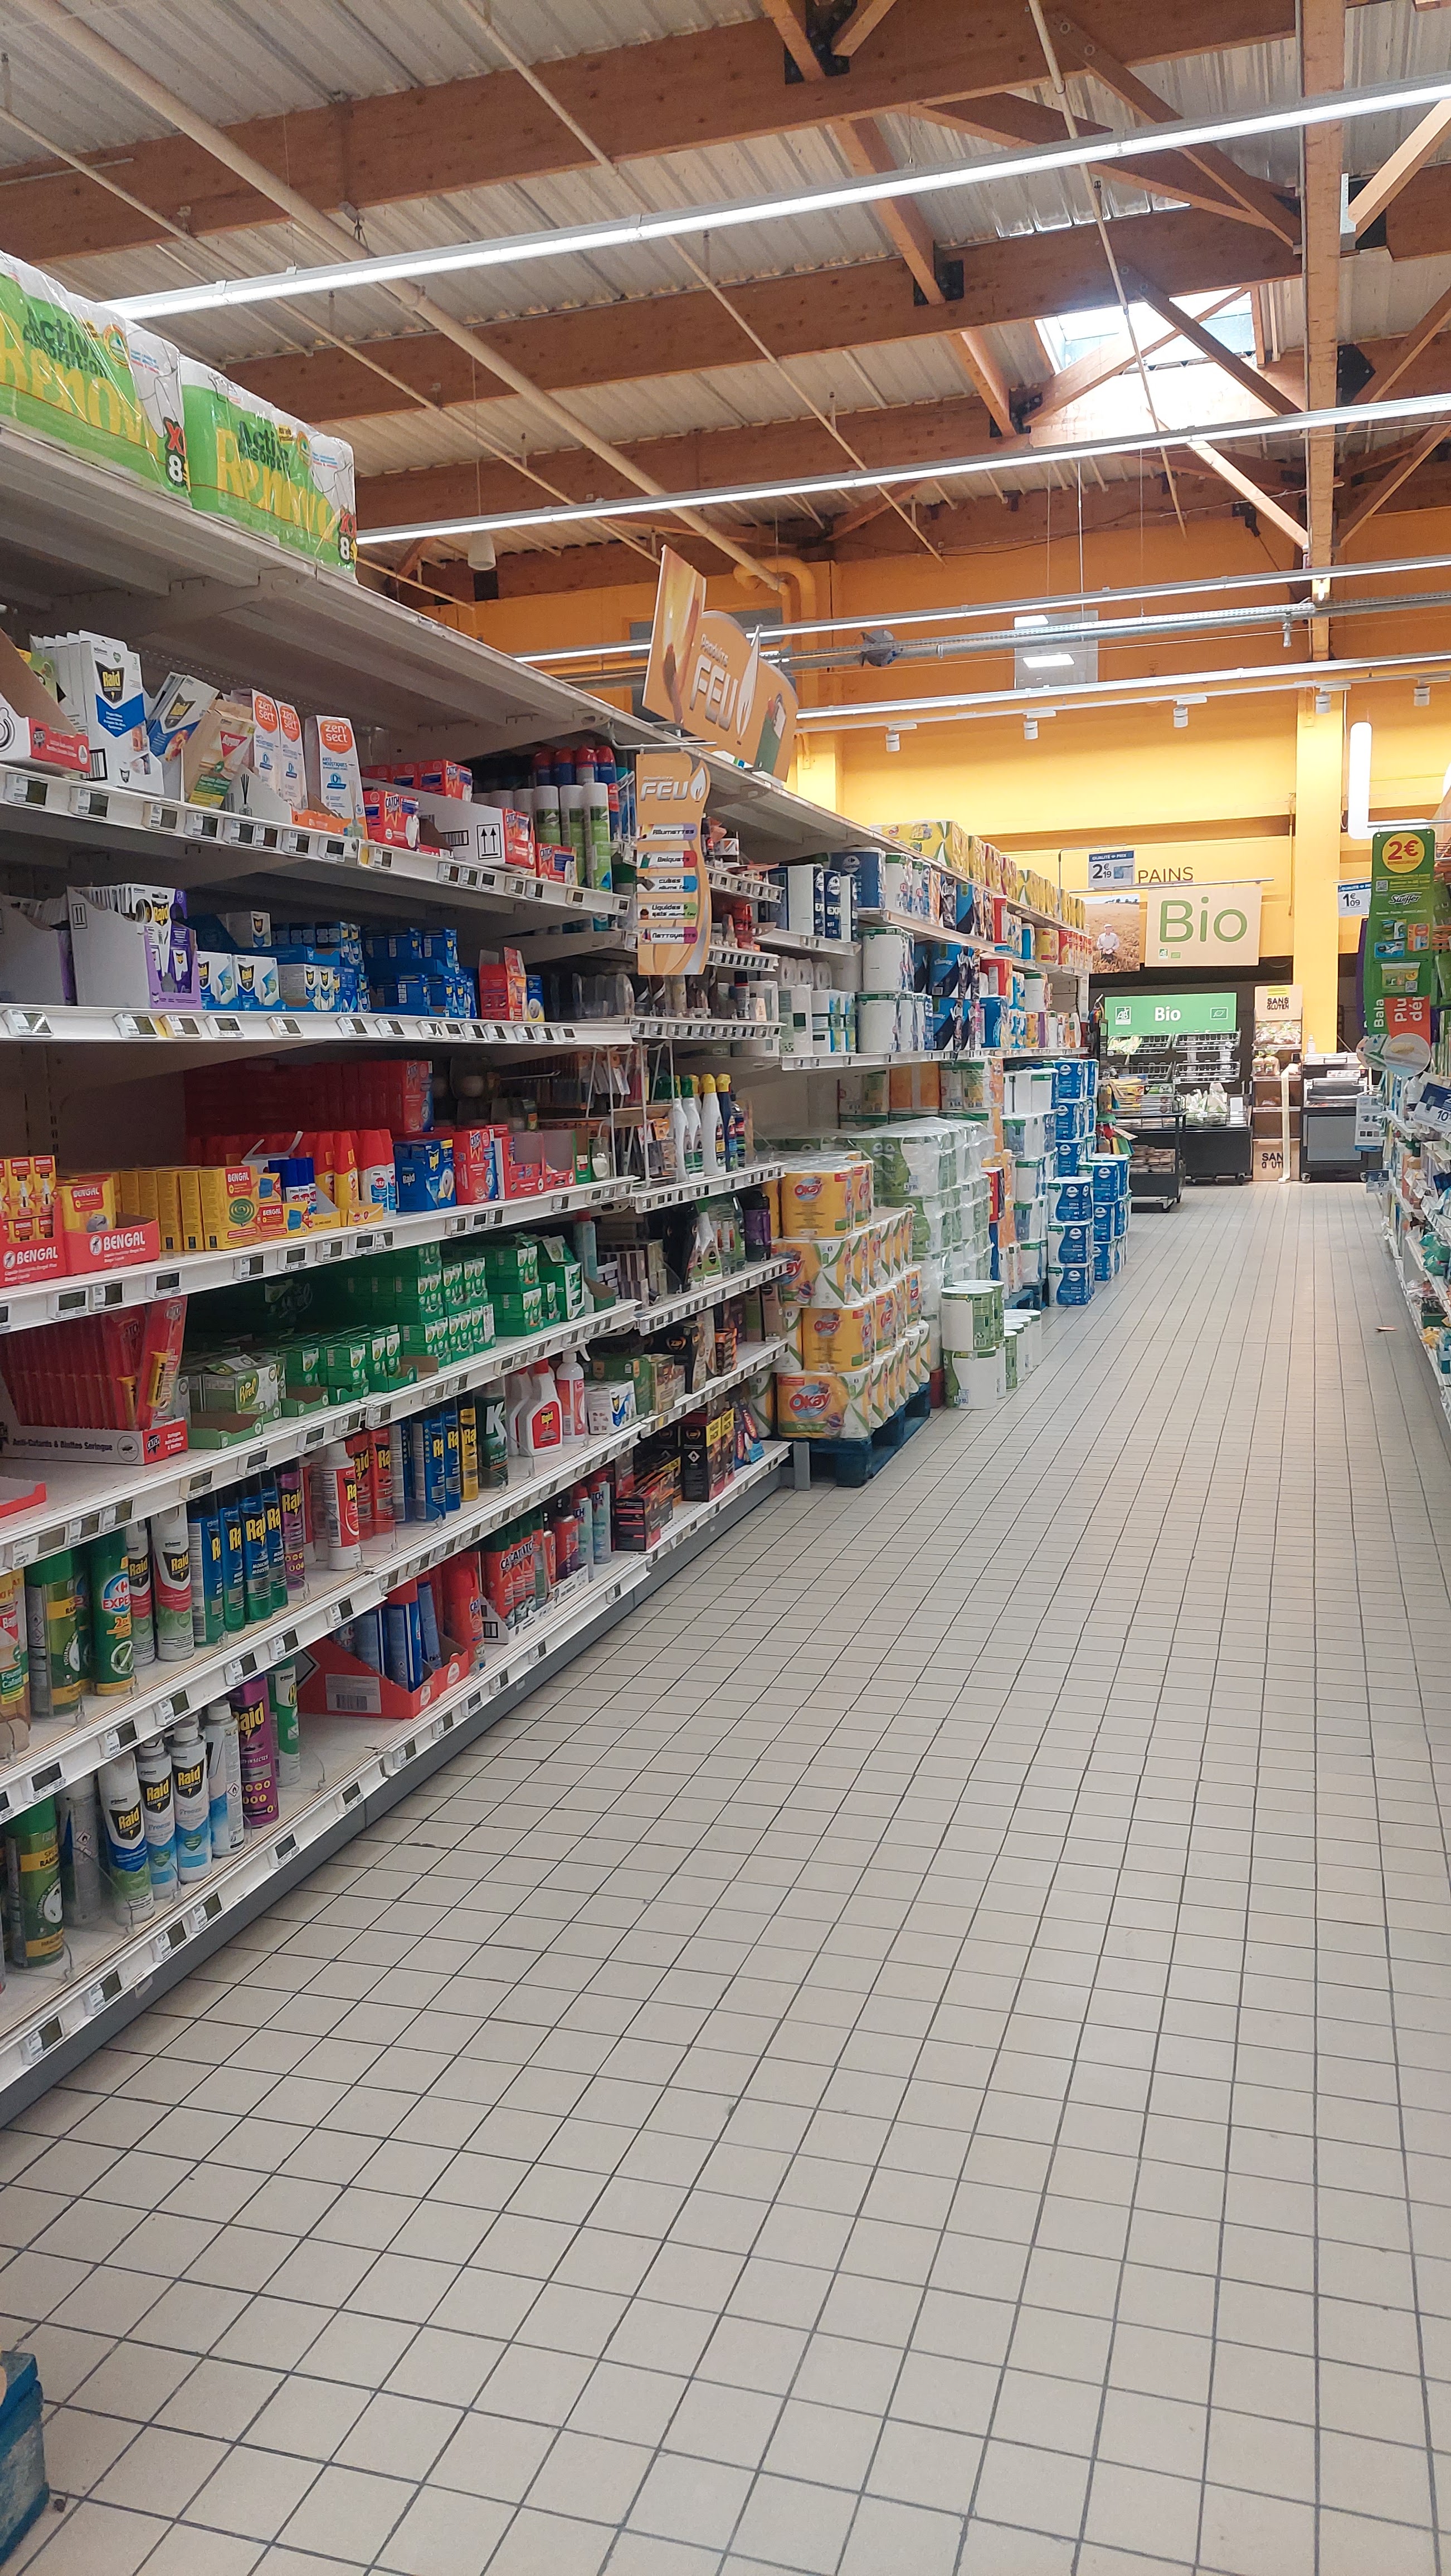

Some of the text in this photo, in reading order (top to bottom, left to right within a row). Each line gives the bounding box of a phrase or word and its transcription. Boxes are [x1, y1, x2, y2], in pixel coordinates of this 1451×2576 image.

[103, 670, 121, 687] Raid
[689, 654, 738, 731] FEU
[259, 710, 275, 723] sect
[326, 733, 348, 743] sect
[640, 781, 689, 801] FEU
[385, 796, 400, 808] CATCH
[1092, 863, 1103, 879] 2
[1103, 870, 1112, 879] 19
[1138, 866, 1194, 884] PAINS
[1343, 893, 1350, 907] 1
[1389, 893, 1421, 905] Swiffer
[153, 904, 168, 922] Raid
[1159, 896, 1248, 943] Bio
[198, 965, 207, 977] aid
[241, 968, 252, 980] Raid
[1155, 1006, 1181, 1022] Bio
[1262, 1152, 1284, 1162] SAN
[227, 1172, 250, 1183] BENGAL
[402, 1173, 416, 1184] Raid
[72, 1187, 100, 1198] BENGAL
[794, 1182, 823, 1197] Okay
[262, 1208, 281, 1216] BENGAL
[103, 1231, 146, 1251] BENGAL
[16, 1246, 59, 1265] BENGAL
[814, 1319, 842, 1333] Okay
[789, 1392, 832, 1412] Okay
[147, 1435, 160, 1450] CATCH
[448, 1431, 459, 1449] Ra
[464, 1428, 477, 1444] Ra
[84, 1442, 113, 1452] Seringue
[433, 1439, 444, 1458] Ra
[354, 1452, 369, 1472] aid
[378, 1450, 390, 1468] Ra
[347, 1484, 357, 1501] Ra
[245, 1513, 266, 1541] Rai
[267, 1507, 281, 1530] Ra
[229, 1527, 242, 1552] Ra
[129, 1557, 148, 1577] Raid
[171, 1550, 188, 1570] Raid
[103, 1594, 130, 1609] EXPE
[178, 1765, 201, 1786] Raid
[147, 1779, 169, 1802] Raid
[118, 1807, 140, 1829] Raid
